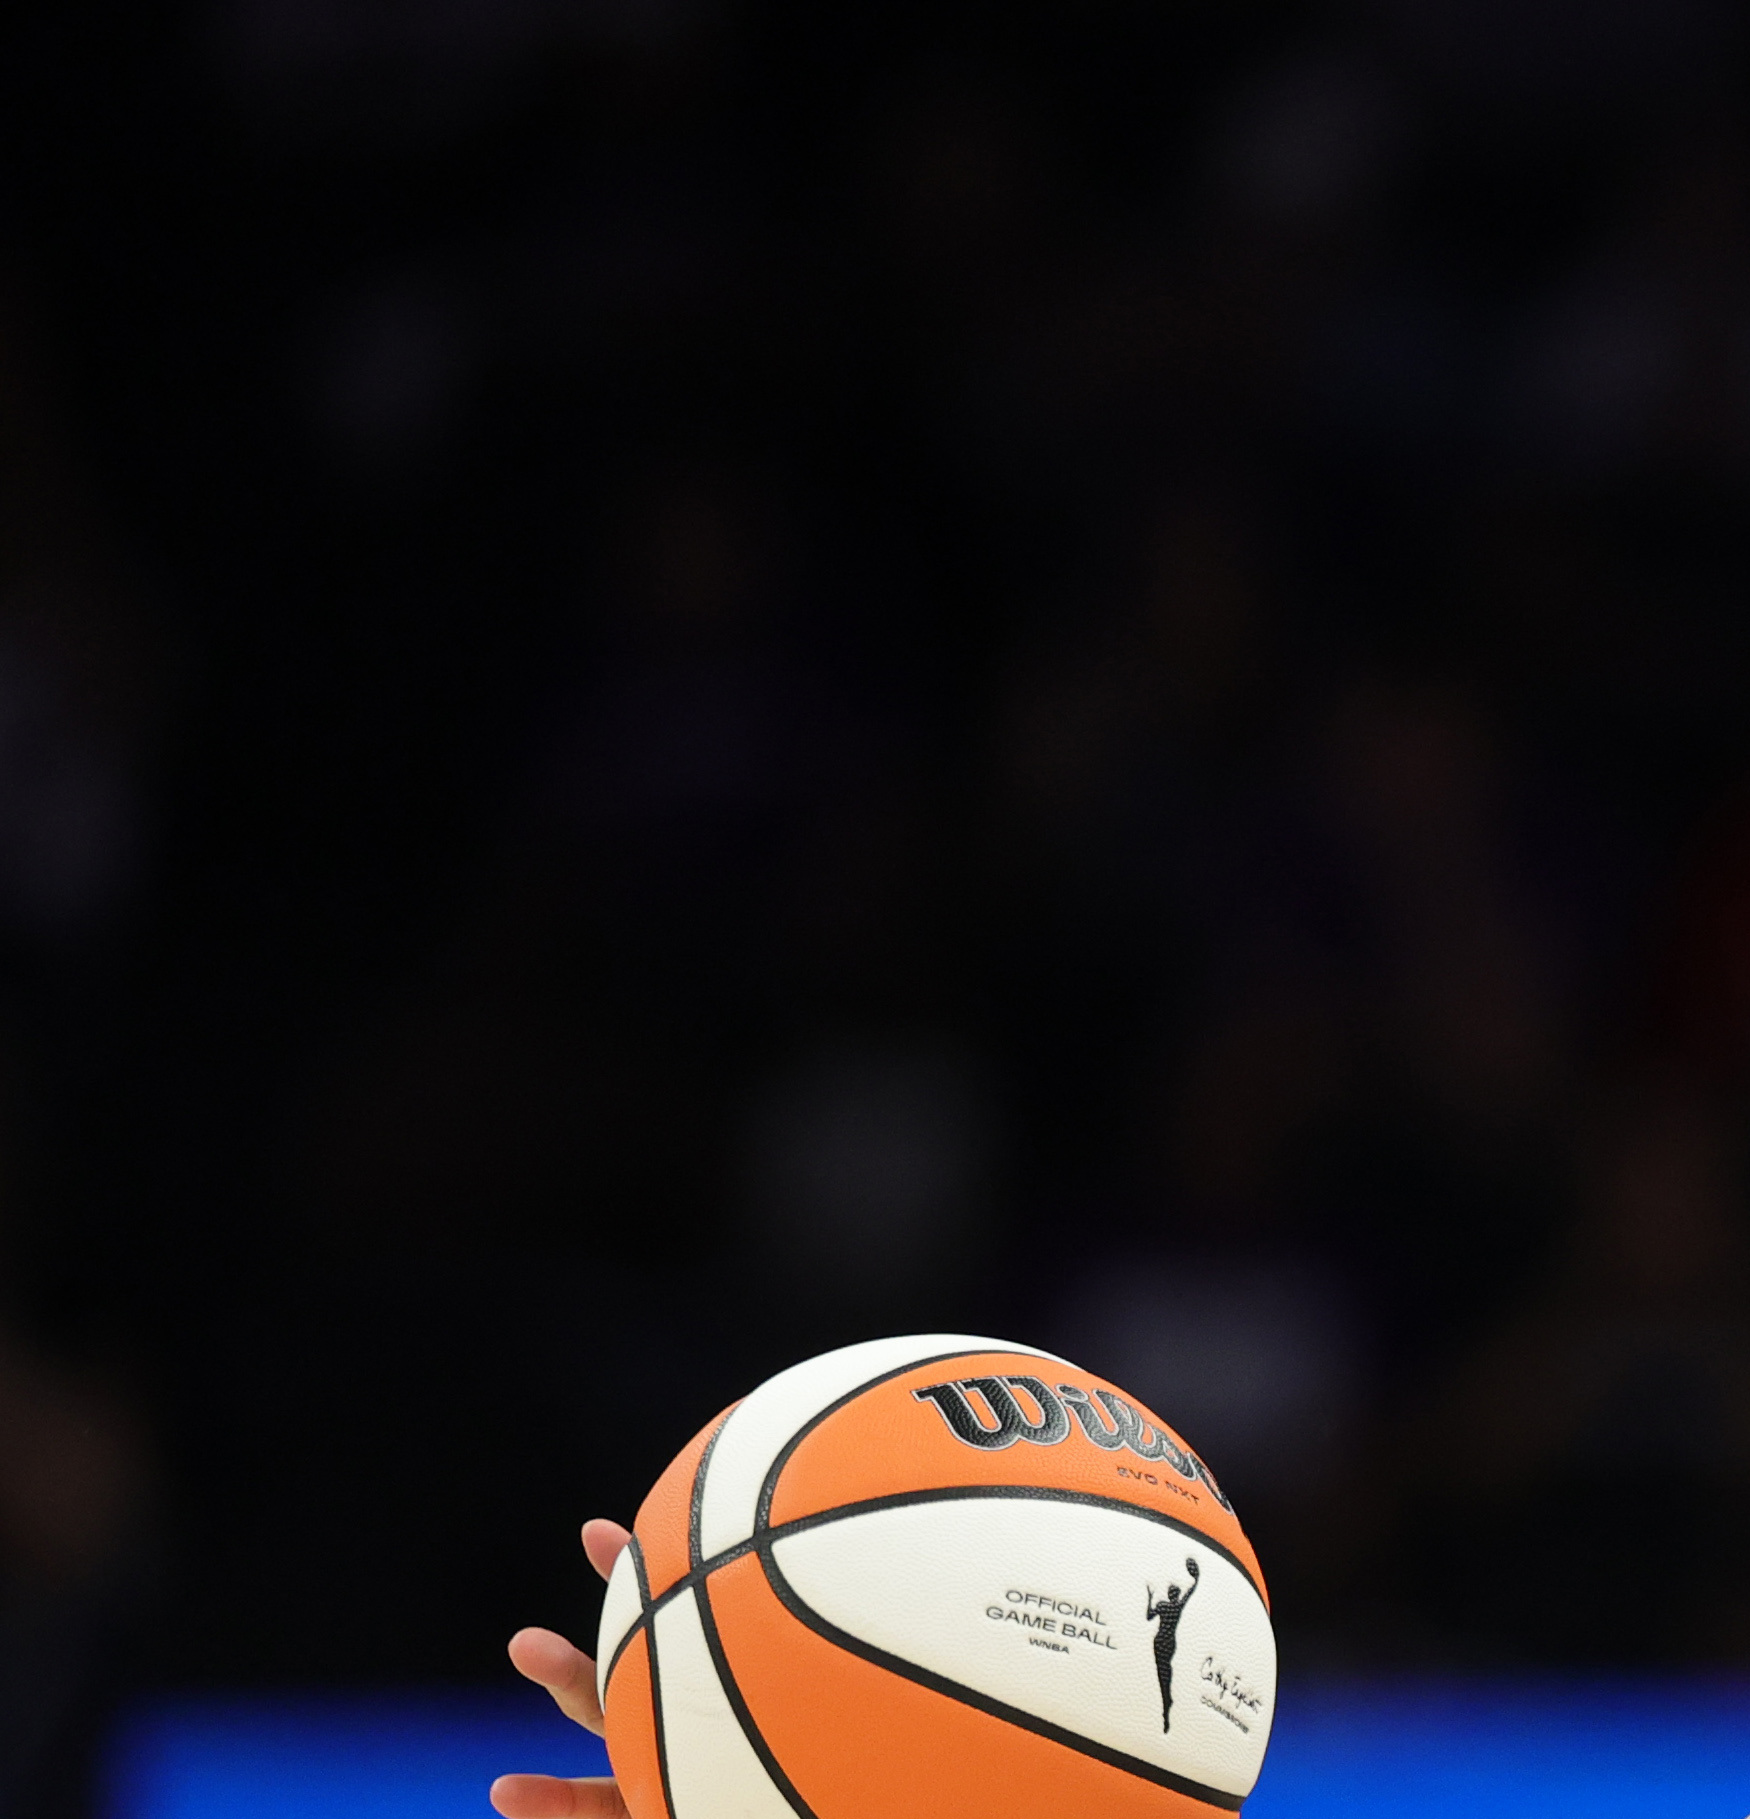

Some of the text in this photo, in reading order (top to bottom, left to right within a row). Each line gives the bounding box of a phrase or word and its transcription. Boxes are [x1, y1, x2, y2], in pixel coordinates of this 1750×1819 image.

[1115, 1465, 1159, 1486] EVO
[1005, 1589, 1107, 1626] OFFICIAL
[985, 1605, 1119, 1651] GAME BALL
[1028, 1636, 1071, 1655] WNBA
